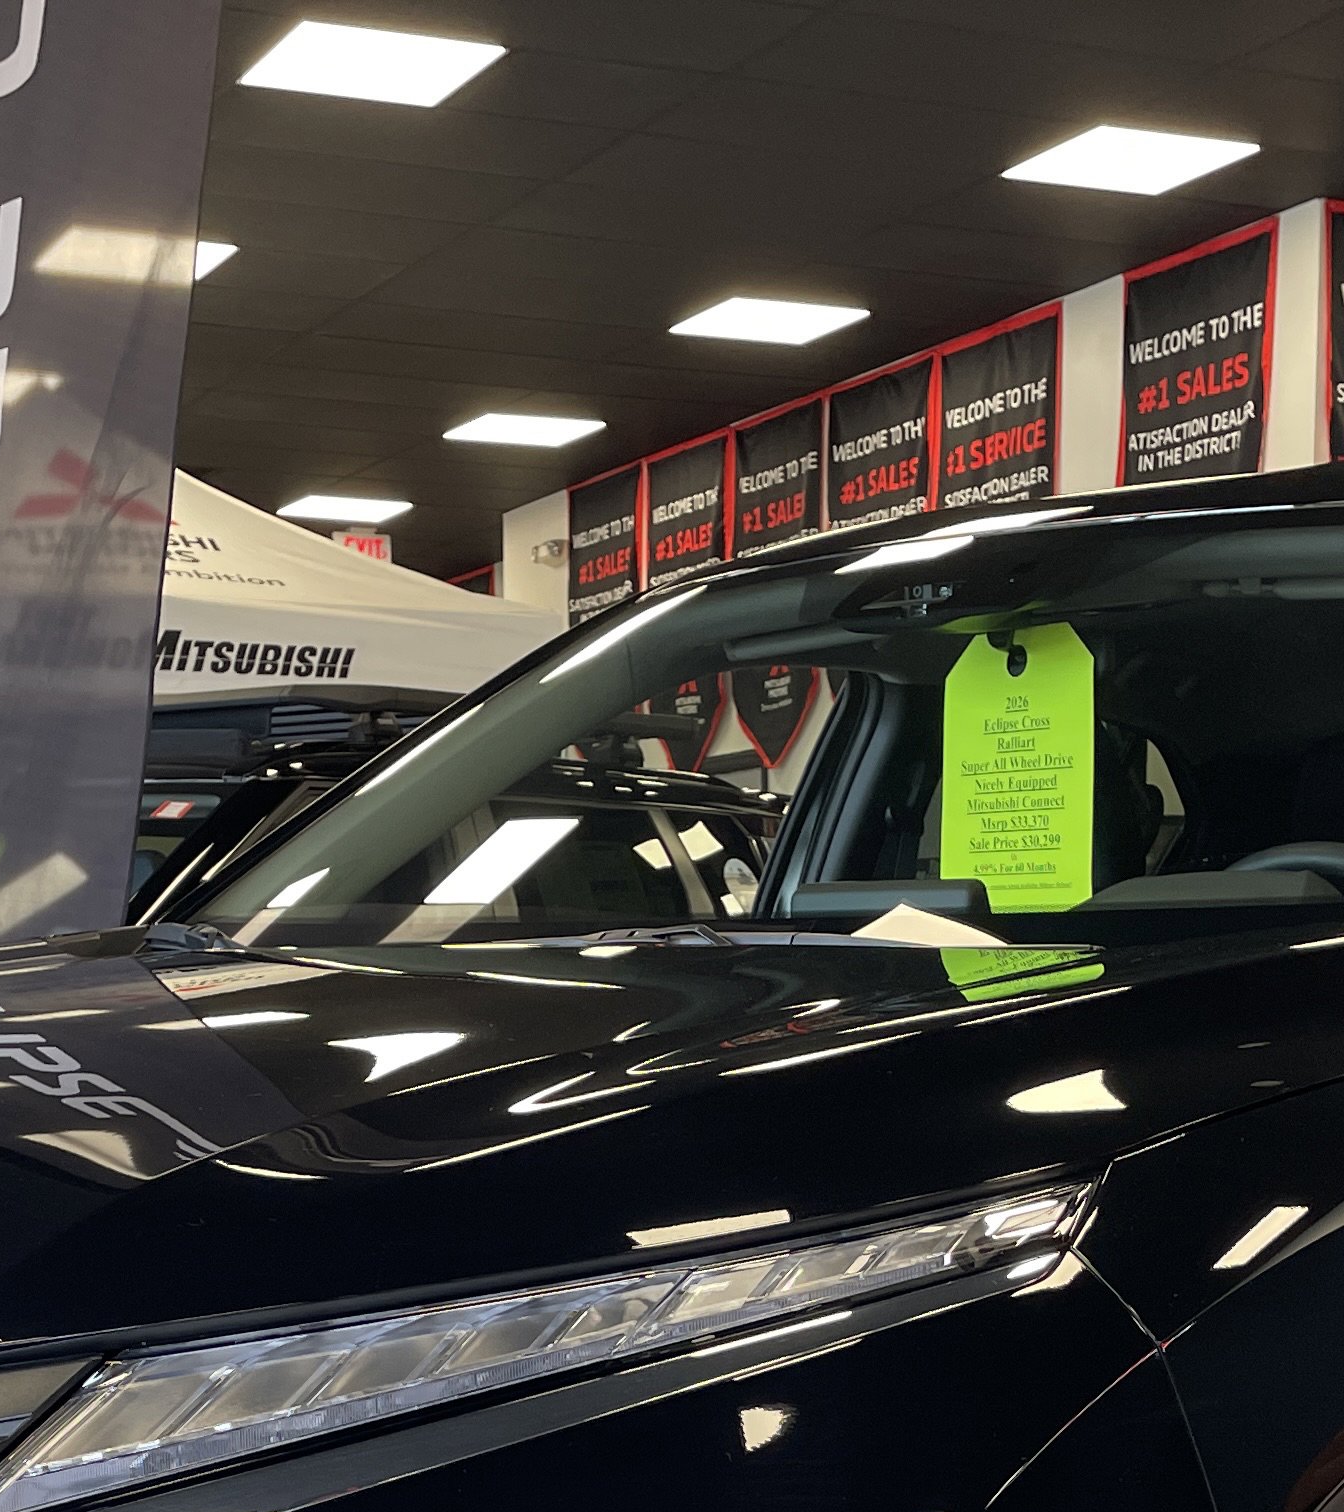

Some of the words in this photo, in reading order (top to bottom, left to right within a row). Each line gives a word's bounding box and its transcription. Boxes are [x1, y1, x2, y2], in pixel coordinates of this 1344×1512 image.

[1129, 321, 1205, 365] WELCOME
[1209, 315, 1229, 341] TO
[1231, 302, 1264, 334] THE
[1006, 387, 1021, 409] TO
[1023, 377, 1047, 405] THE
[1138, 377, 1170, 415] #1
[1176, 353, 1249, 405] SALES
[832, 430, 888, 462] WELCOME
[890, 426, 902, 445] TO
[969, 418, 1047, 471] SERVICE
[1128, 415, 1208, 451] ATISFACTION
[1138, 454, 1154, 472] IN
[1157, 446, 1183, 469] THE
[1184, 430, 1242, 462] DISTRICT!
[840, 475, 864, 504] #1
[868, 457, 919, 496] SALES
[165, 568, 286, 586] mbition
[156, 629, 355, 679] MITSUBISHI
[1006, 696, 1029, 710] 2026
[984, 718, 1019, 732] Eclipse
[1022, 716, 1050, 728] Cross
[961, 760, 990, 774] Super
[993, 758, 1007, 770] All
[1010, 755, 1041, 769] Wheel
[1044, 753, 1073, 766] Drive
[976, 778, 1004, 791] Nicely
[1008, 774, 1057, 790] Equipped
[968, 797, 1019, 811] Mitsubishi
[1022, 795, 1064, 807] Connect
[969, 837, 990, 850] Sale
[993, 836, 1019, 849] Price
